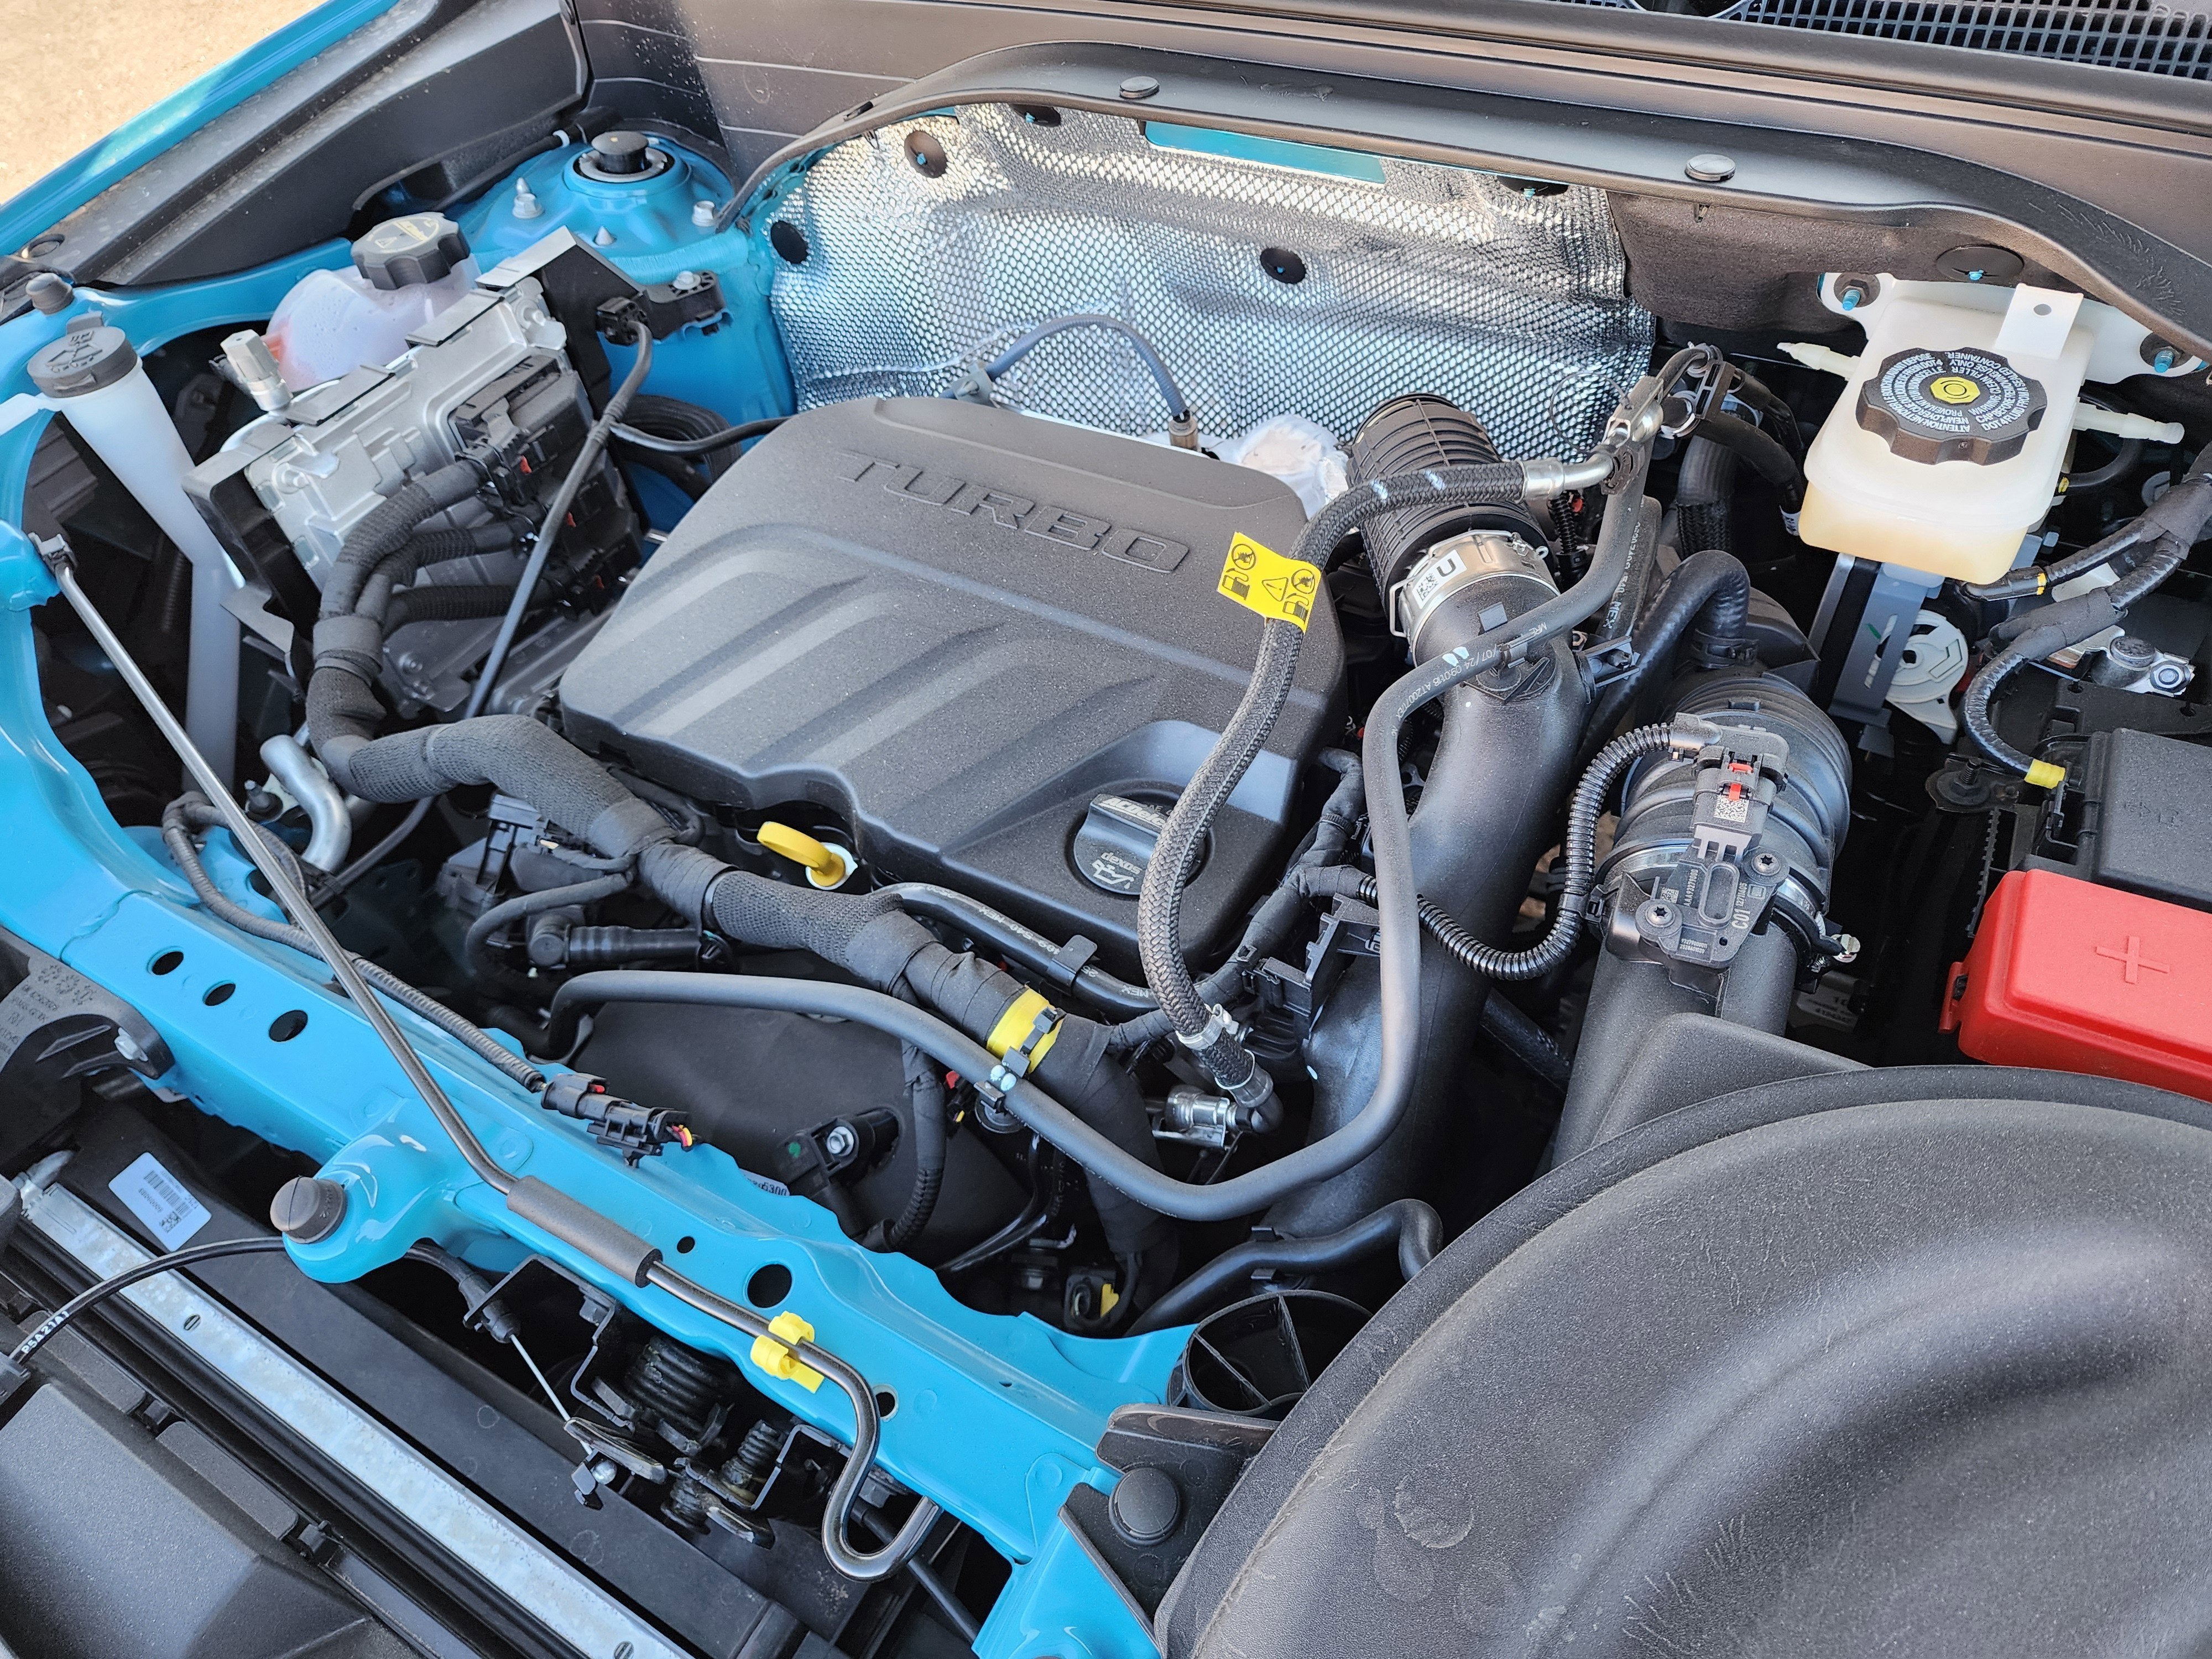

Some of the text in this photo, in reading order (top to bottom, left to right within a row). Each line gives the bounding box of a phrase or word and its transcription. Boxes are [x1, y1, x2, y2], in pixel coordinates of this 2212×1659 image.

[1919, 360, 1937, 369] DOT
[1952, 366, 1984, 378] FILLER
[1974, 364, 1993, 374] USE
[1983, 375, 2001, 394] CLEAN
[1999, 367, 2026, 387] SEALED
[1916, 399, 1962, 417] PROVENANT
[1994, 398, 2015, 417] BEFORE
[2016, 392, 2030, 408] FROM
[1889, 402, 1924, 424] NETTOYER
[1976, 412, 1996, 423] CAP
[2003, 407, 2025, 422] FLUID
[1981, 419, 2004, 431] DOT
[834, 450, 1190, 574] TURBO
[1437, 559, 1456, 577] U
[1603, 601, 1621, 629] MEX
[1100, 797, 1167, 828] ACDelc
[1100, 852, 1143, 874] dexos
[978, 907, 1005, 924] MEX
[1731, 909, 1750, 930] C01
[1121, 985, 1150, 998] MEX
[21, 1311, 70, 1354] P5A21A1
